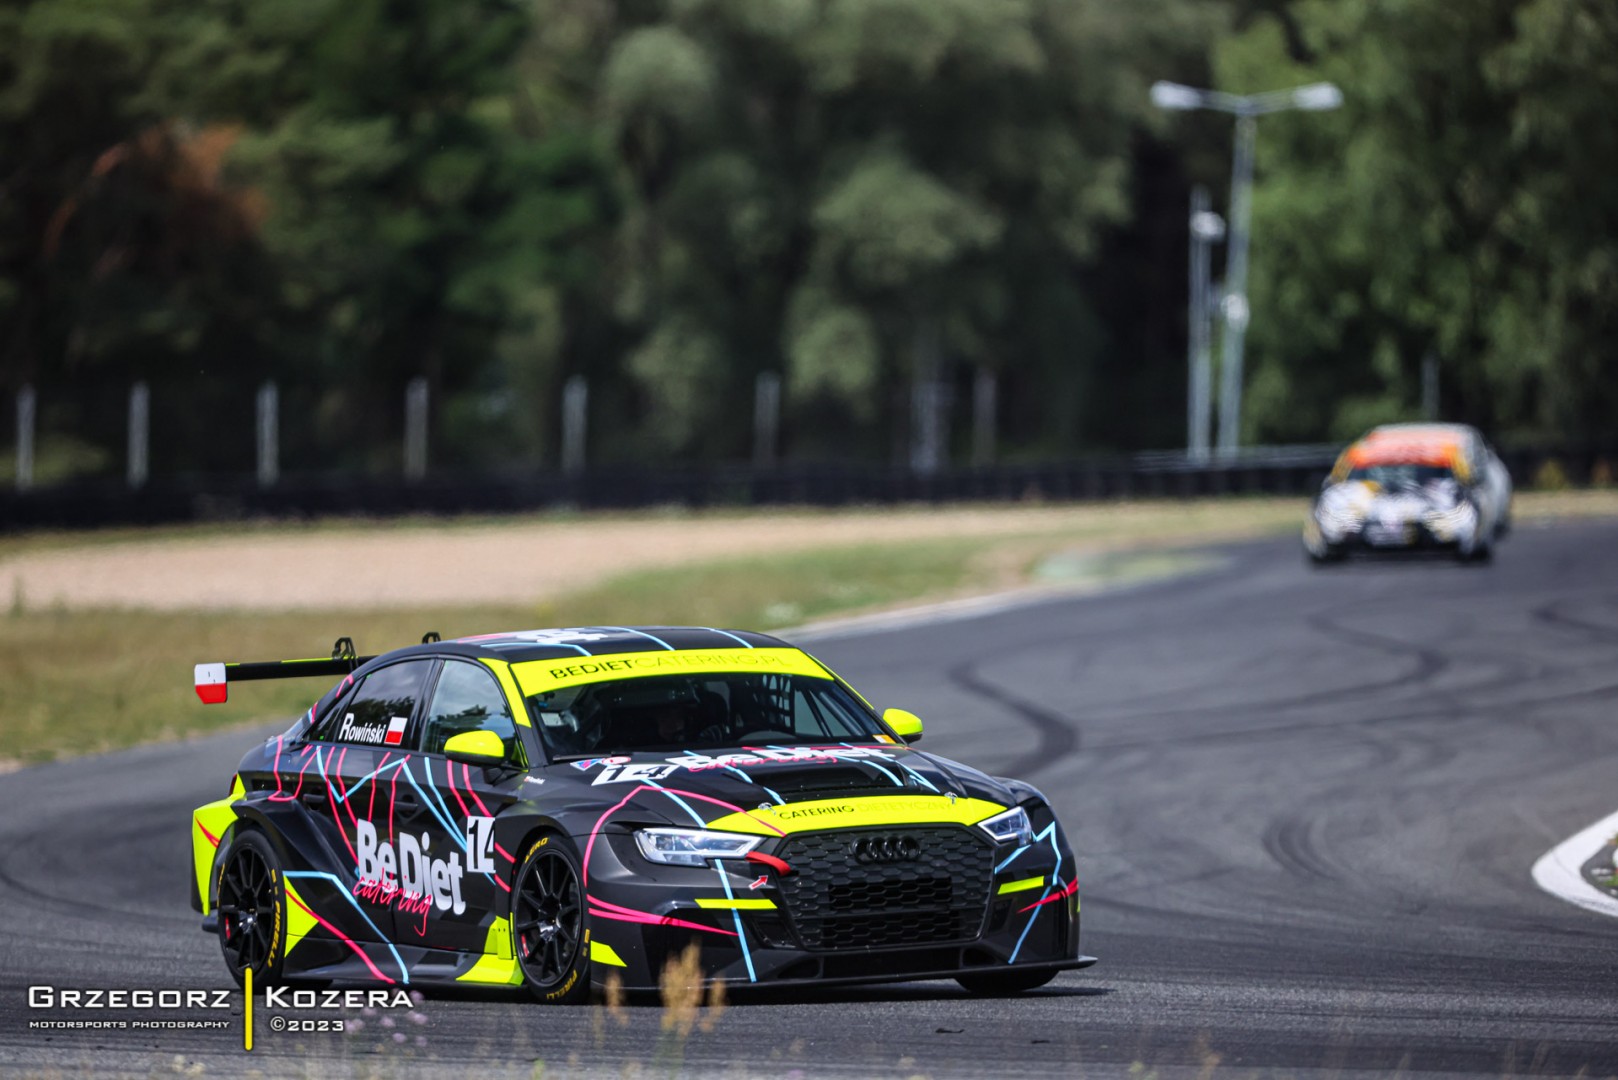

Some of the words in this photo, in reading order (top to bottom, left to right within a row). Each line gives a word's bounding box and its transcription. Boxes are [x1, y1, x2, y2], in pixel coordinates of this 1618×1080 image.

[549, 654, 792, 679] BEDIETCATERING.PL
[338, 712, 387, 744] Rowiński
[606, 764, 669, 782] 14
[778, 805, 855, 820] CATERING
[468, 819, 496, 870] 14
